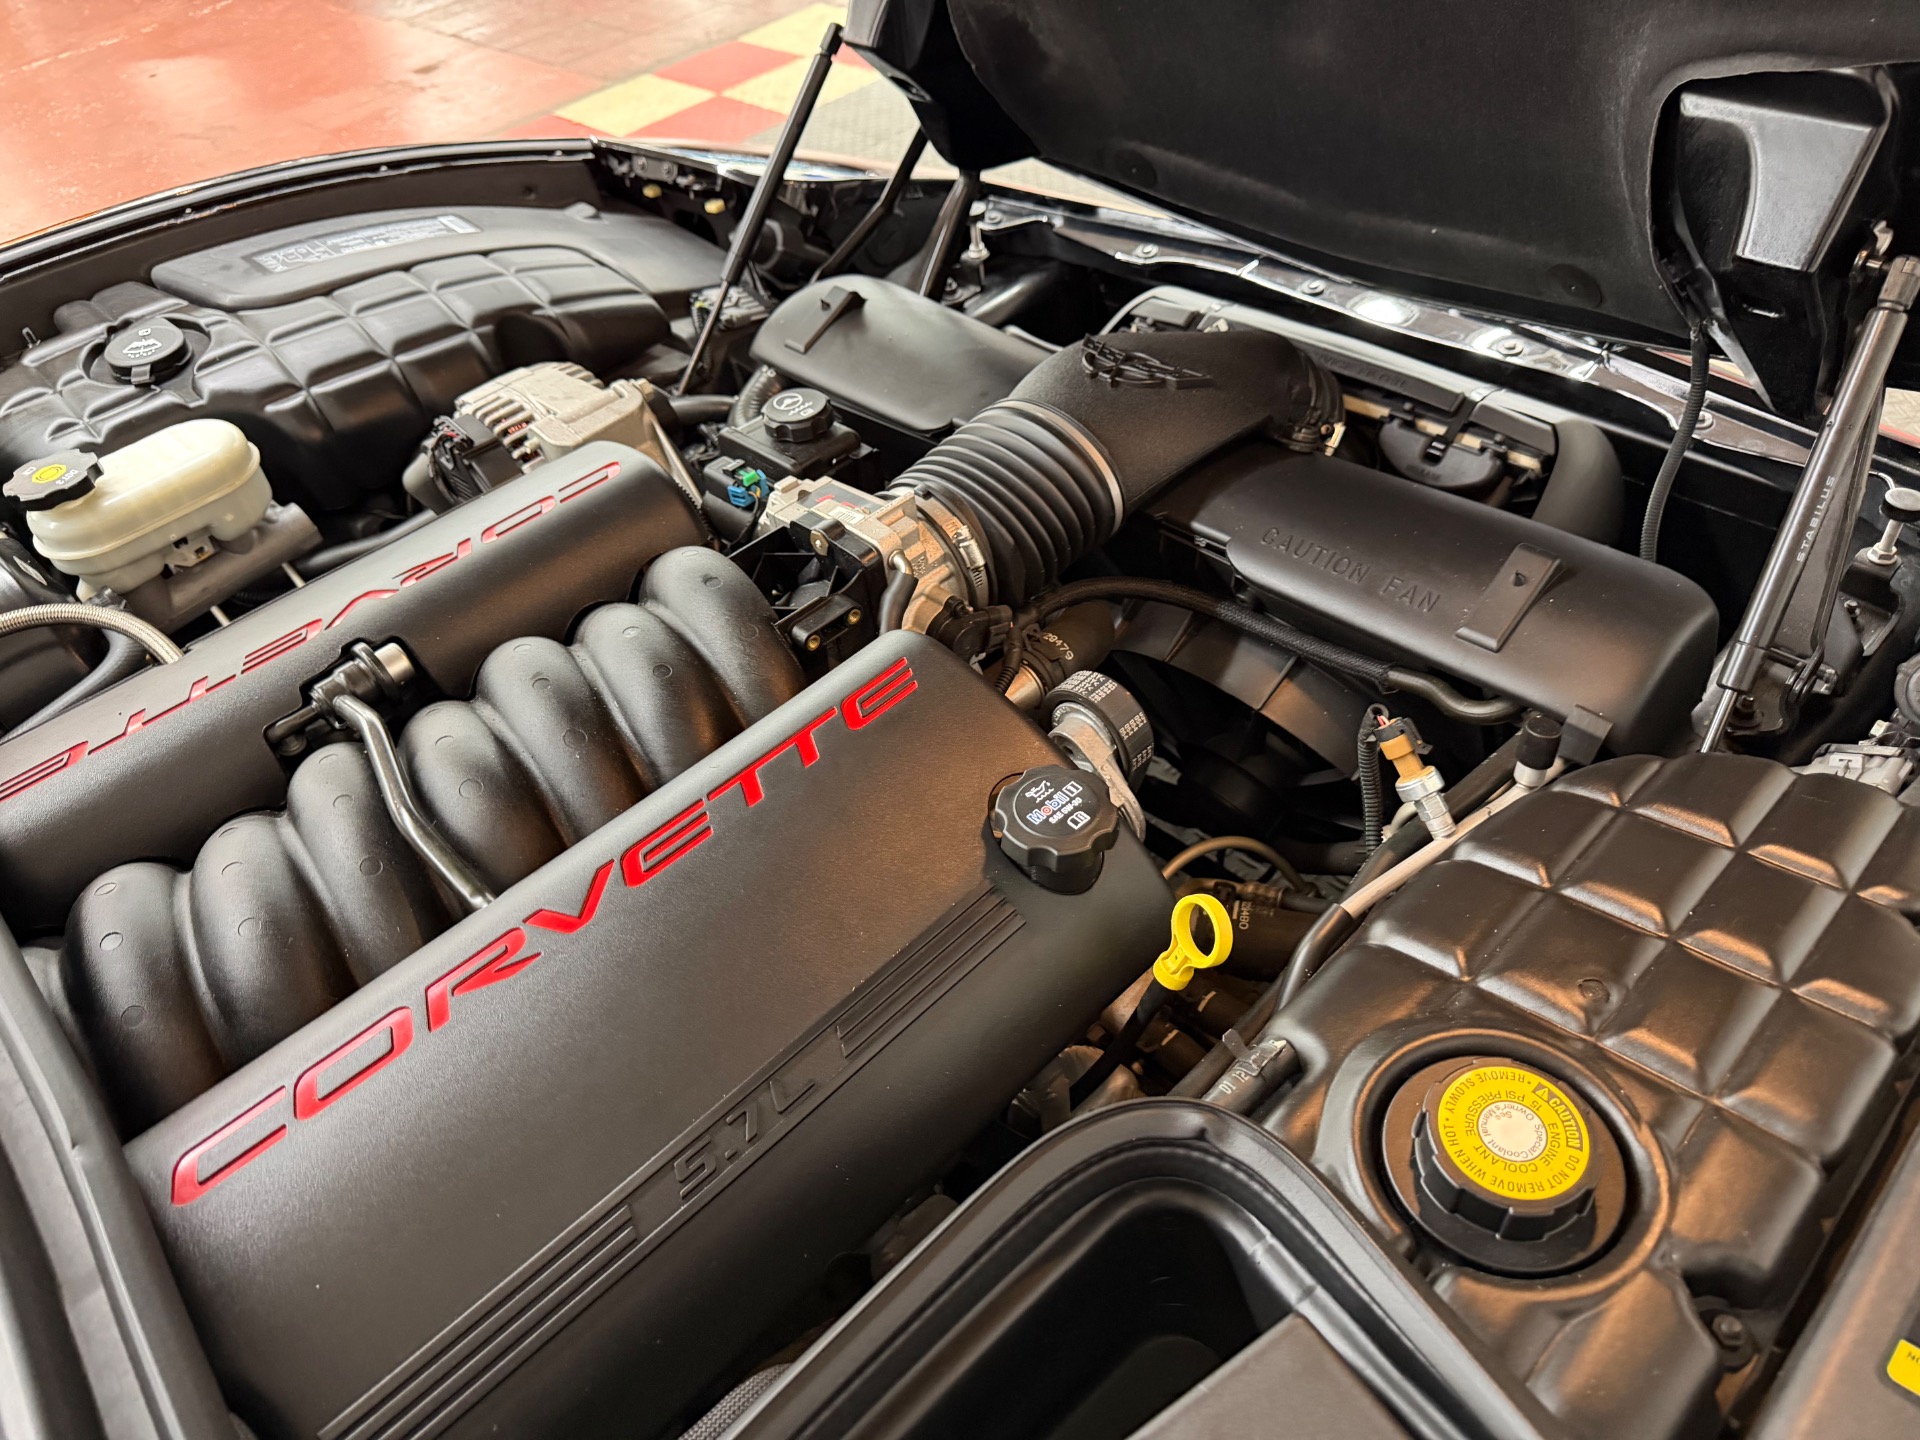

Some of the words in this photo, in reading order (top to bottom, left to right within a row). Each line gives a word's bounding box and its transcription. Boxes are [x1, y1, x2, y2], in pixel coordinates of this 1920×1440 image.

[1796, 475, 1835, 562] STABILUS
[1260, 527, 1372, 584] CAUTION
[1379, 576, 1442, 613] FAN
[0, 461, 621, 802] CORVETTE
[1026, 791, 1070, 825] Mobil
[1048, 811, 1064, 824] SAE
[1061, 797, 1083, 814] 5W-30
[169, 656, 920, 1207] CORVETTE
[1475, 1070, 1525, 1084] REMOVE
[1445, 1078, 1476, 1114] SLOWLY
[1505, 1090, 1526, 1103] PSI
[1529, 1100, 1543, 1112] 15
[1464, 1090, 1502, 1137] PRESSURE
[1480, 1109, 1497, 1137] Manual
[1495, 1103, 1535, 1122] Owner's
[1548, 1097, 1582, 1151] CAUTION
[673, 1077, 817, 1200] 5.7L
[1443, 1123, 1460, 1147] HOT
[1486, 1138, 1528, 1159] Coolant
[1527, 1123, 1544, 1158] Special
[1542, 1122, 1561, 1167] ENGINE
[1453, 1149, 1487, 1180] WHEN
[1472, 1144, 1539, 1174] COOLANT
[1564, 1154, 1580, 1171] DO
[1489, 1174, 1545, 1194] REMOVE
[1548, 1168, 1570, 1190] NOT
